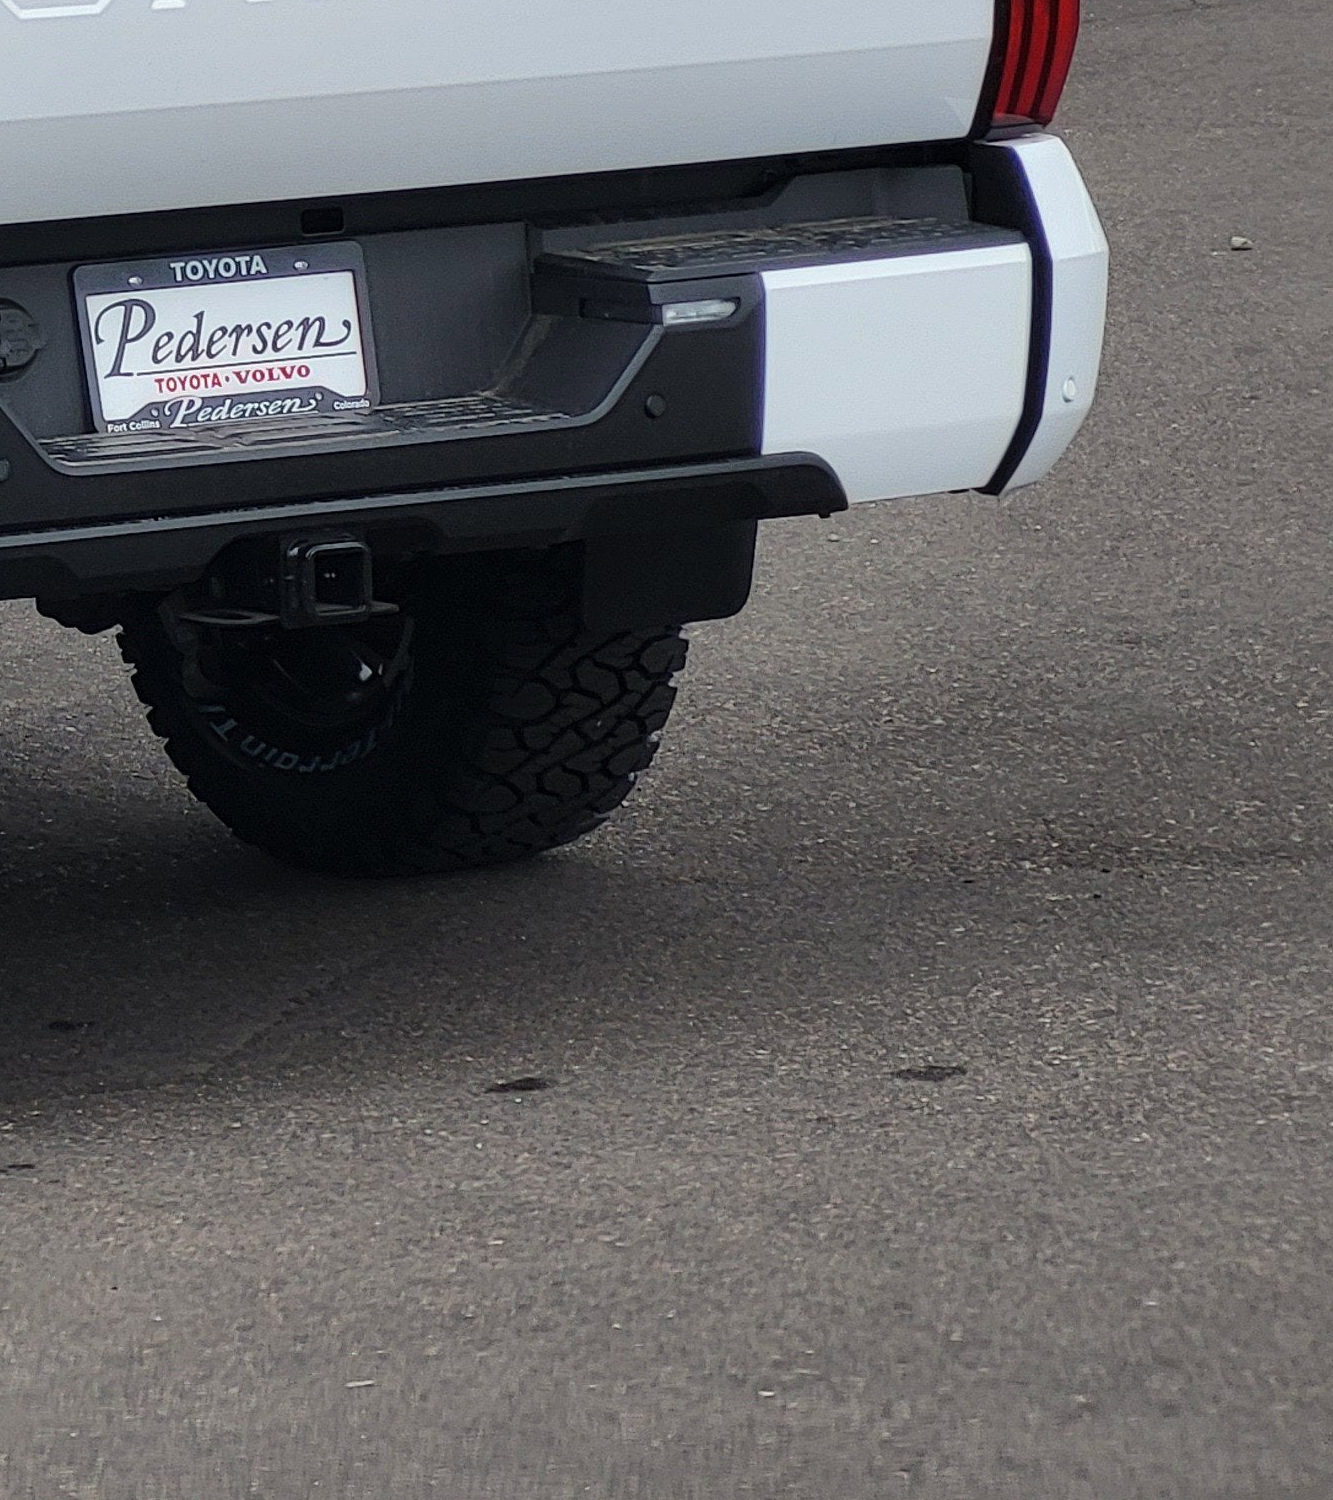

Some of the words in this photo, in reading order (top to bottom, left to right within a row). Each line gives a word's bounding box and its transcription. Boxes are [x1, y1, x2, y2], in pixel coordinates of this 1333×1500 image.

[169, 255, 268, 282] TOYOTA
[95, 298, 352, 380] Pedersen
[154, 375, 223, 394] TOYOTA
[233, 364, 311, 385] VOLVO
[164, 395, 318, 428] Pedersen
[107, 422, 128, 434] Fort
